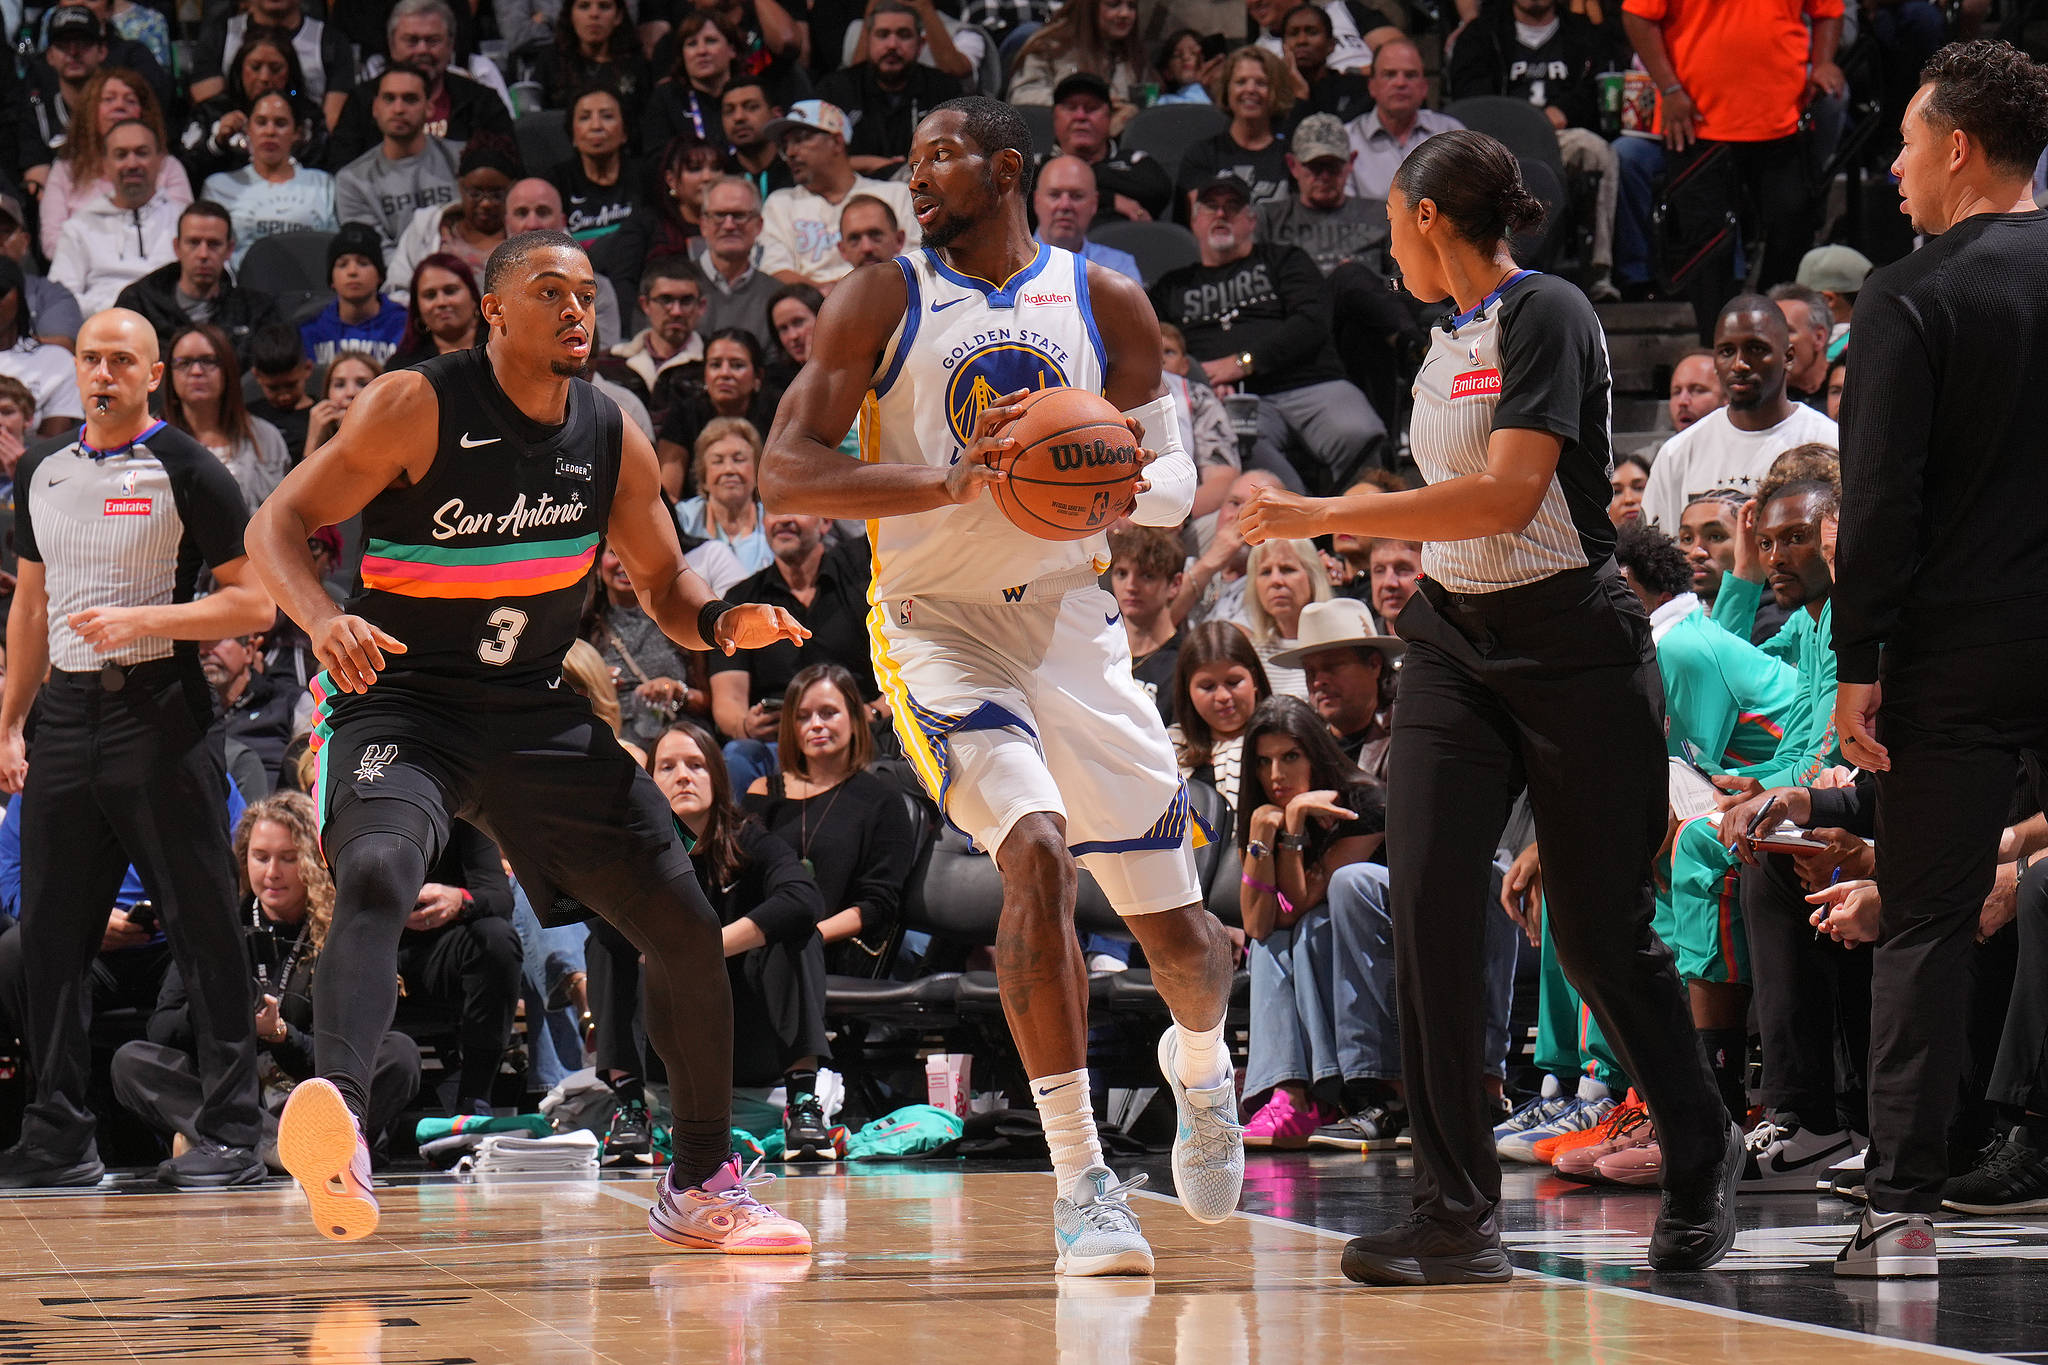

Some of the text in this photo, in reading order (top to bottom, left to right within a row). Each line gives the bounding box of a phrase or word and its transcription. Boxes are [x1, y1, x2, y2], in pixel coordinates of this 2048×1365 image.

[1023, 293, 1072, 306] Rakuten
[1183, 263, 1273, 320] SPURS
[942, 328, 1069, 369] GOLDEN STATE
[1452, 375, 1501, 394] Emirates
[1048, 437, 1136, 472] Wilson
[560, 462, 588, 476] LEDGER
[105, 501, 151, 513] Emirates
[432, 492, 588, 541] San Antonio
[1001, 584, 1028, 603] W
[477, 606, 529, 667] 3
